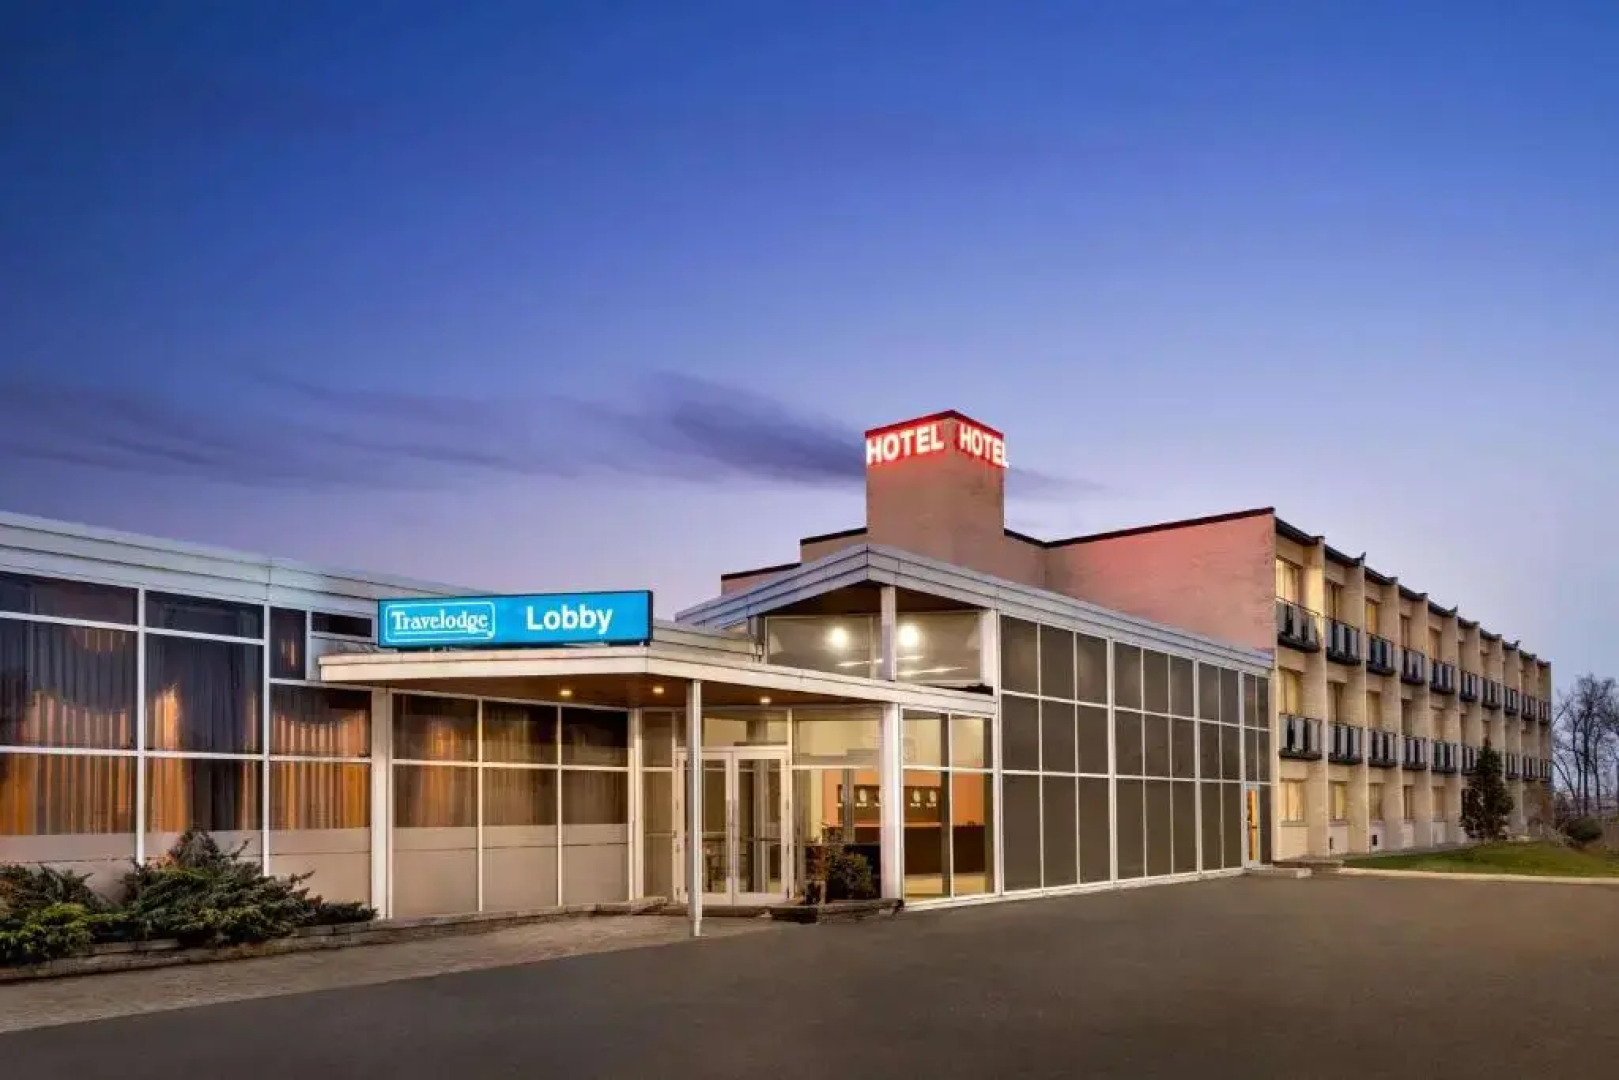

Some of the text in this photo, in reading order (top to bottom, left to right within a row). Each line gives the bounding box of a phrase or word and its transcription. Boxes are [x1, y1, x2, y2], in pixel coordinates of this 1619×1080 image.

[866, 424, 944, 465] HOTEL
[960, 423, 1009, 468] HOTEL
[392, 605, 613, 633] Travelodge Lobby
